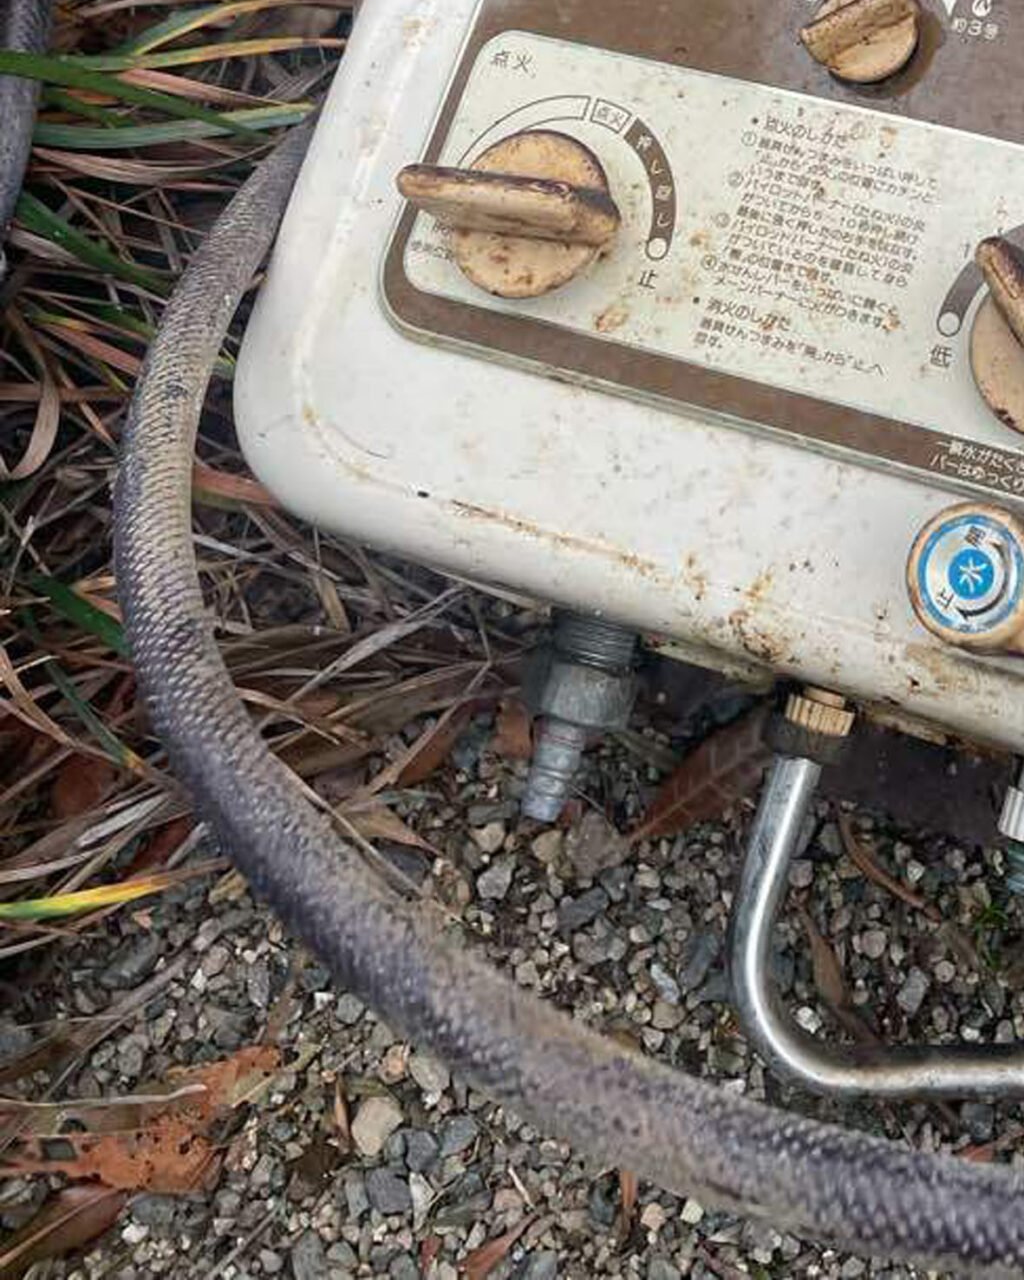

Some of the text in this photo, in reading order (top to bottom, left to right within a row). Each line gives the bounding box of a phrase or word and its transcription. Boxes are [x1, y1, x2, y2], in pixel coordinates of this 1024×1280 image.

[490, 50, 535, 74] 点火
[638, 269, 658, 290] 止
[706, 297, 793, 332] 消火のしかた
[929, 345, 953, 369] 低
[958, 556, 989, 594] 水
